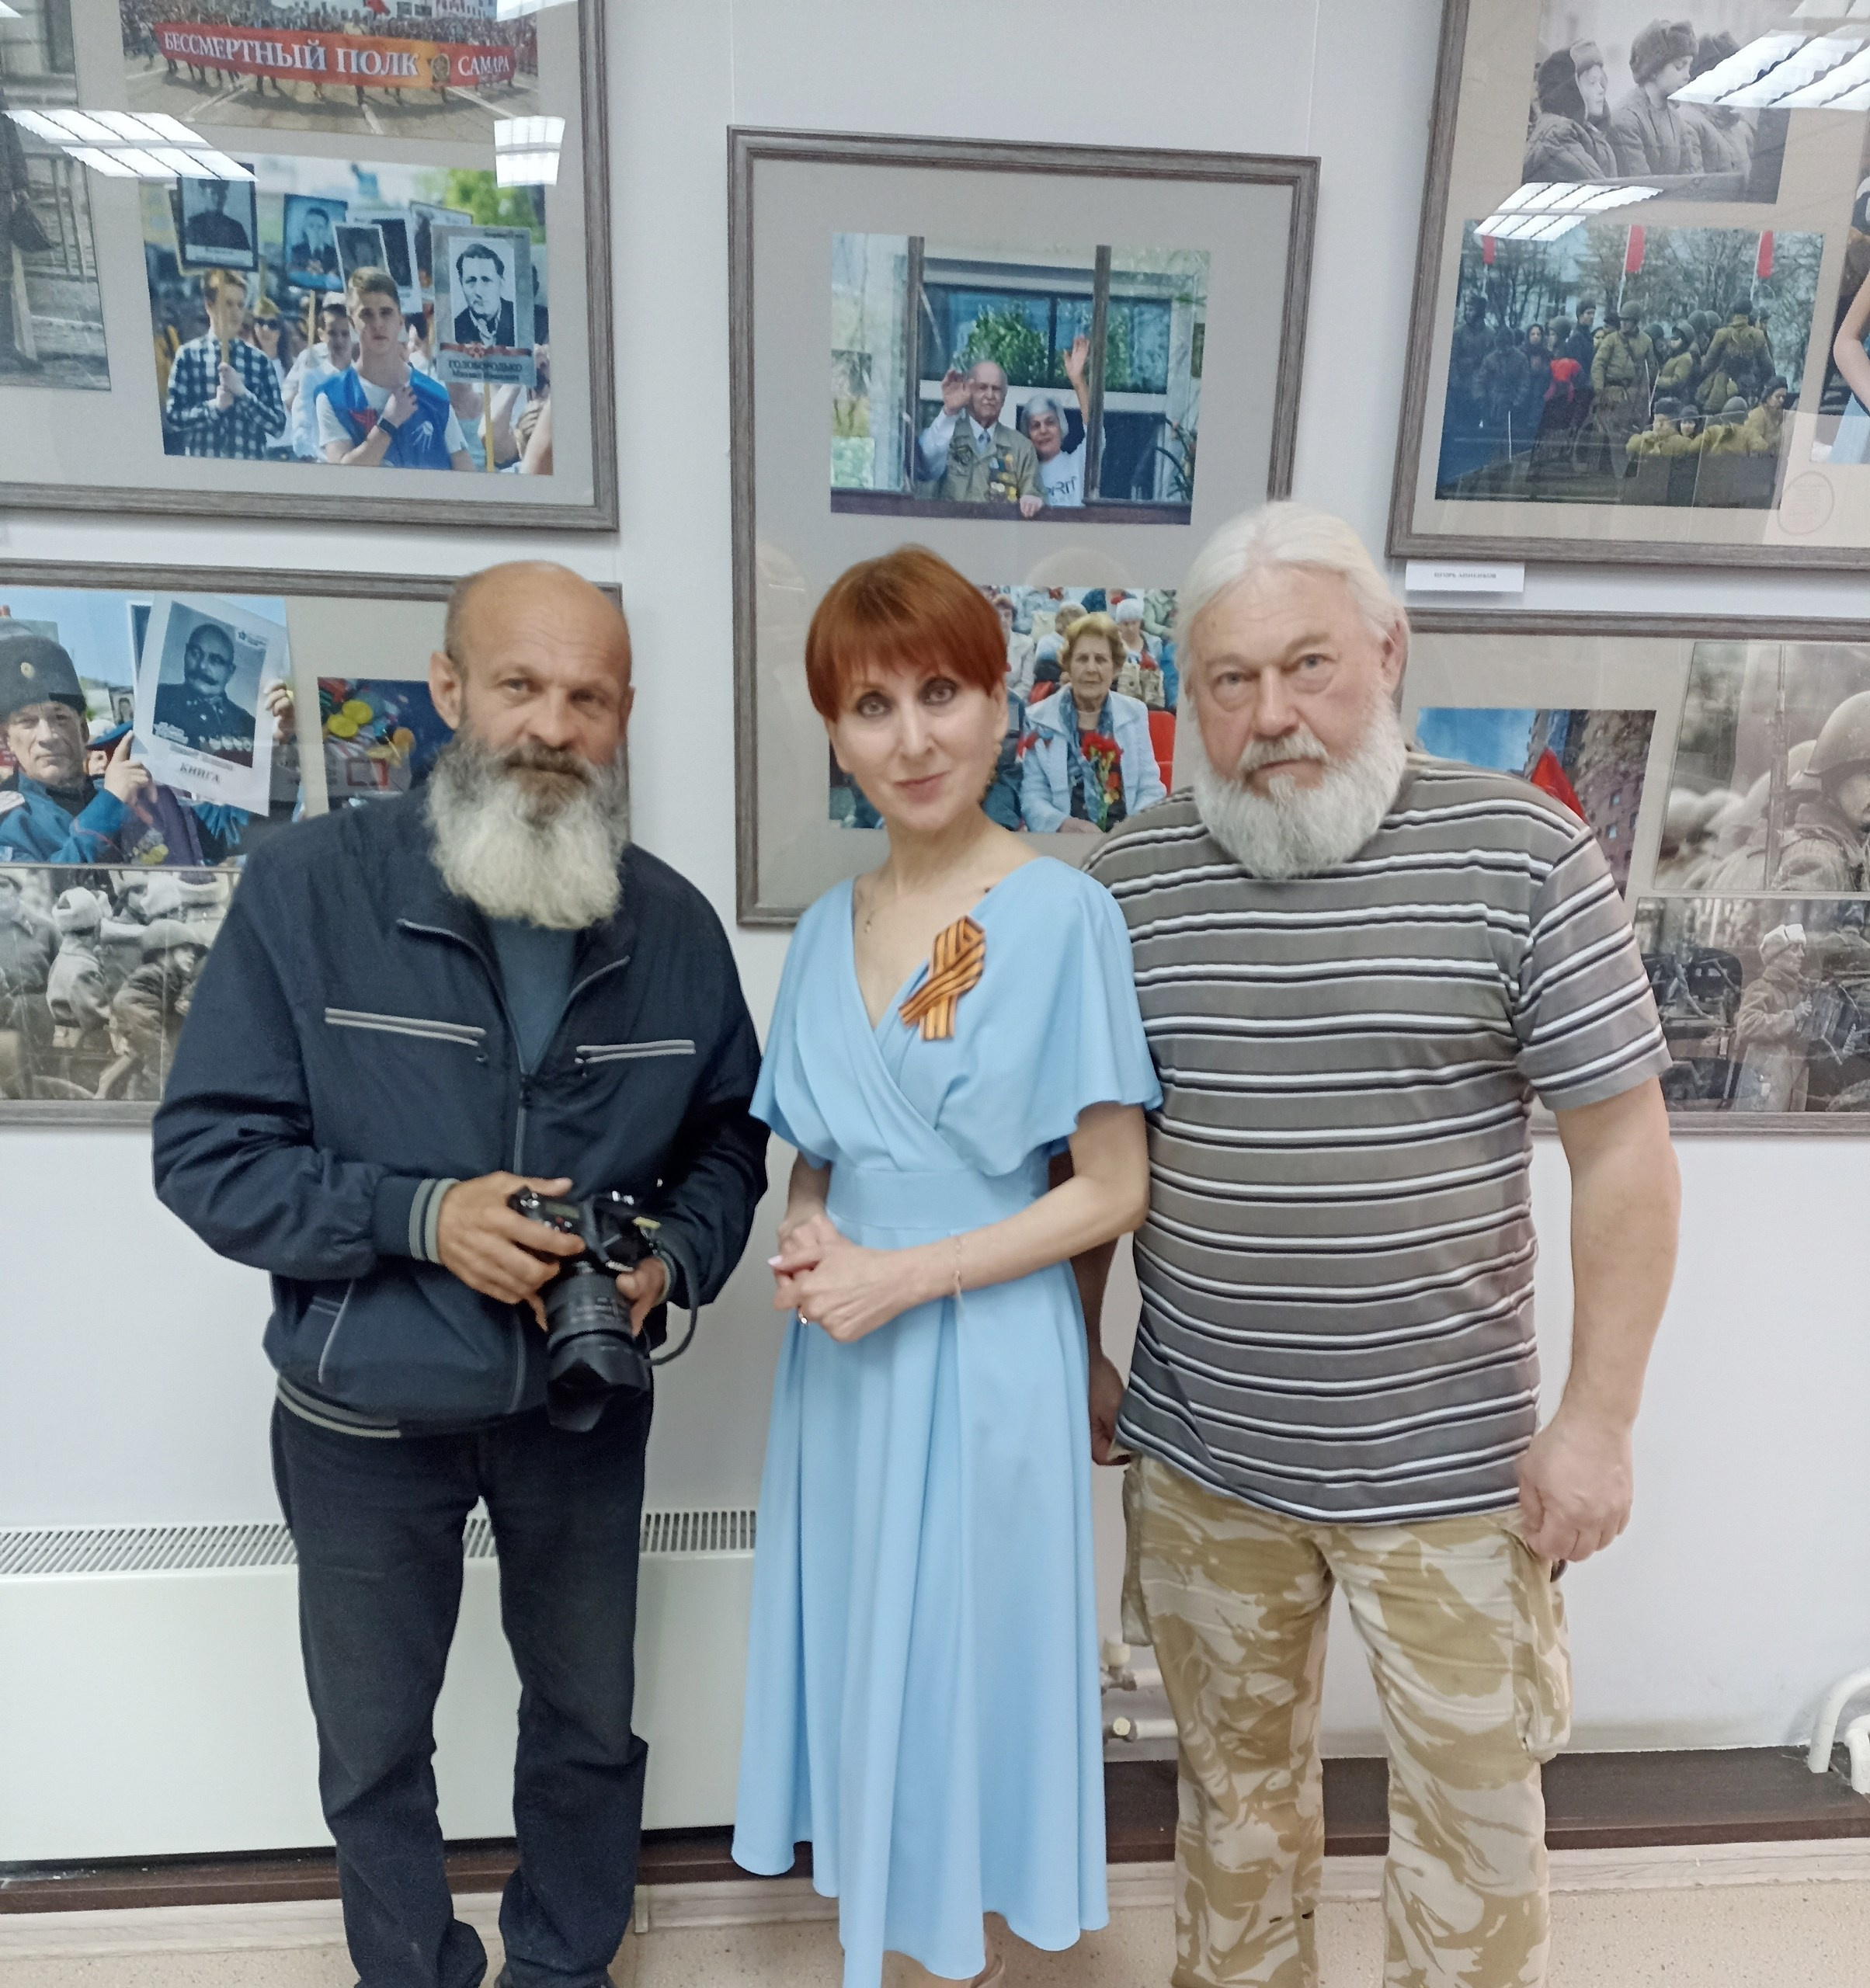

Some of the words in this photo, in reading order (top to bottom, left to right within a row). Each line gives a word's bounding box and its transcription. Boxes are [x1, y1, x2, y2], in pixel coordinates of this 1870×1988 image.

[163, 31, 327, 71] БЕССМЕРТНЫЙ
[335, 47, 419, 76] ПОЛК
[457, 54, 510, 77] САМАРА
[179, 762, 221, 784] КНИГА
